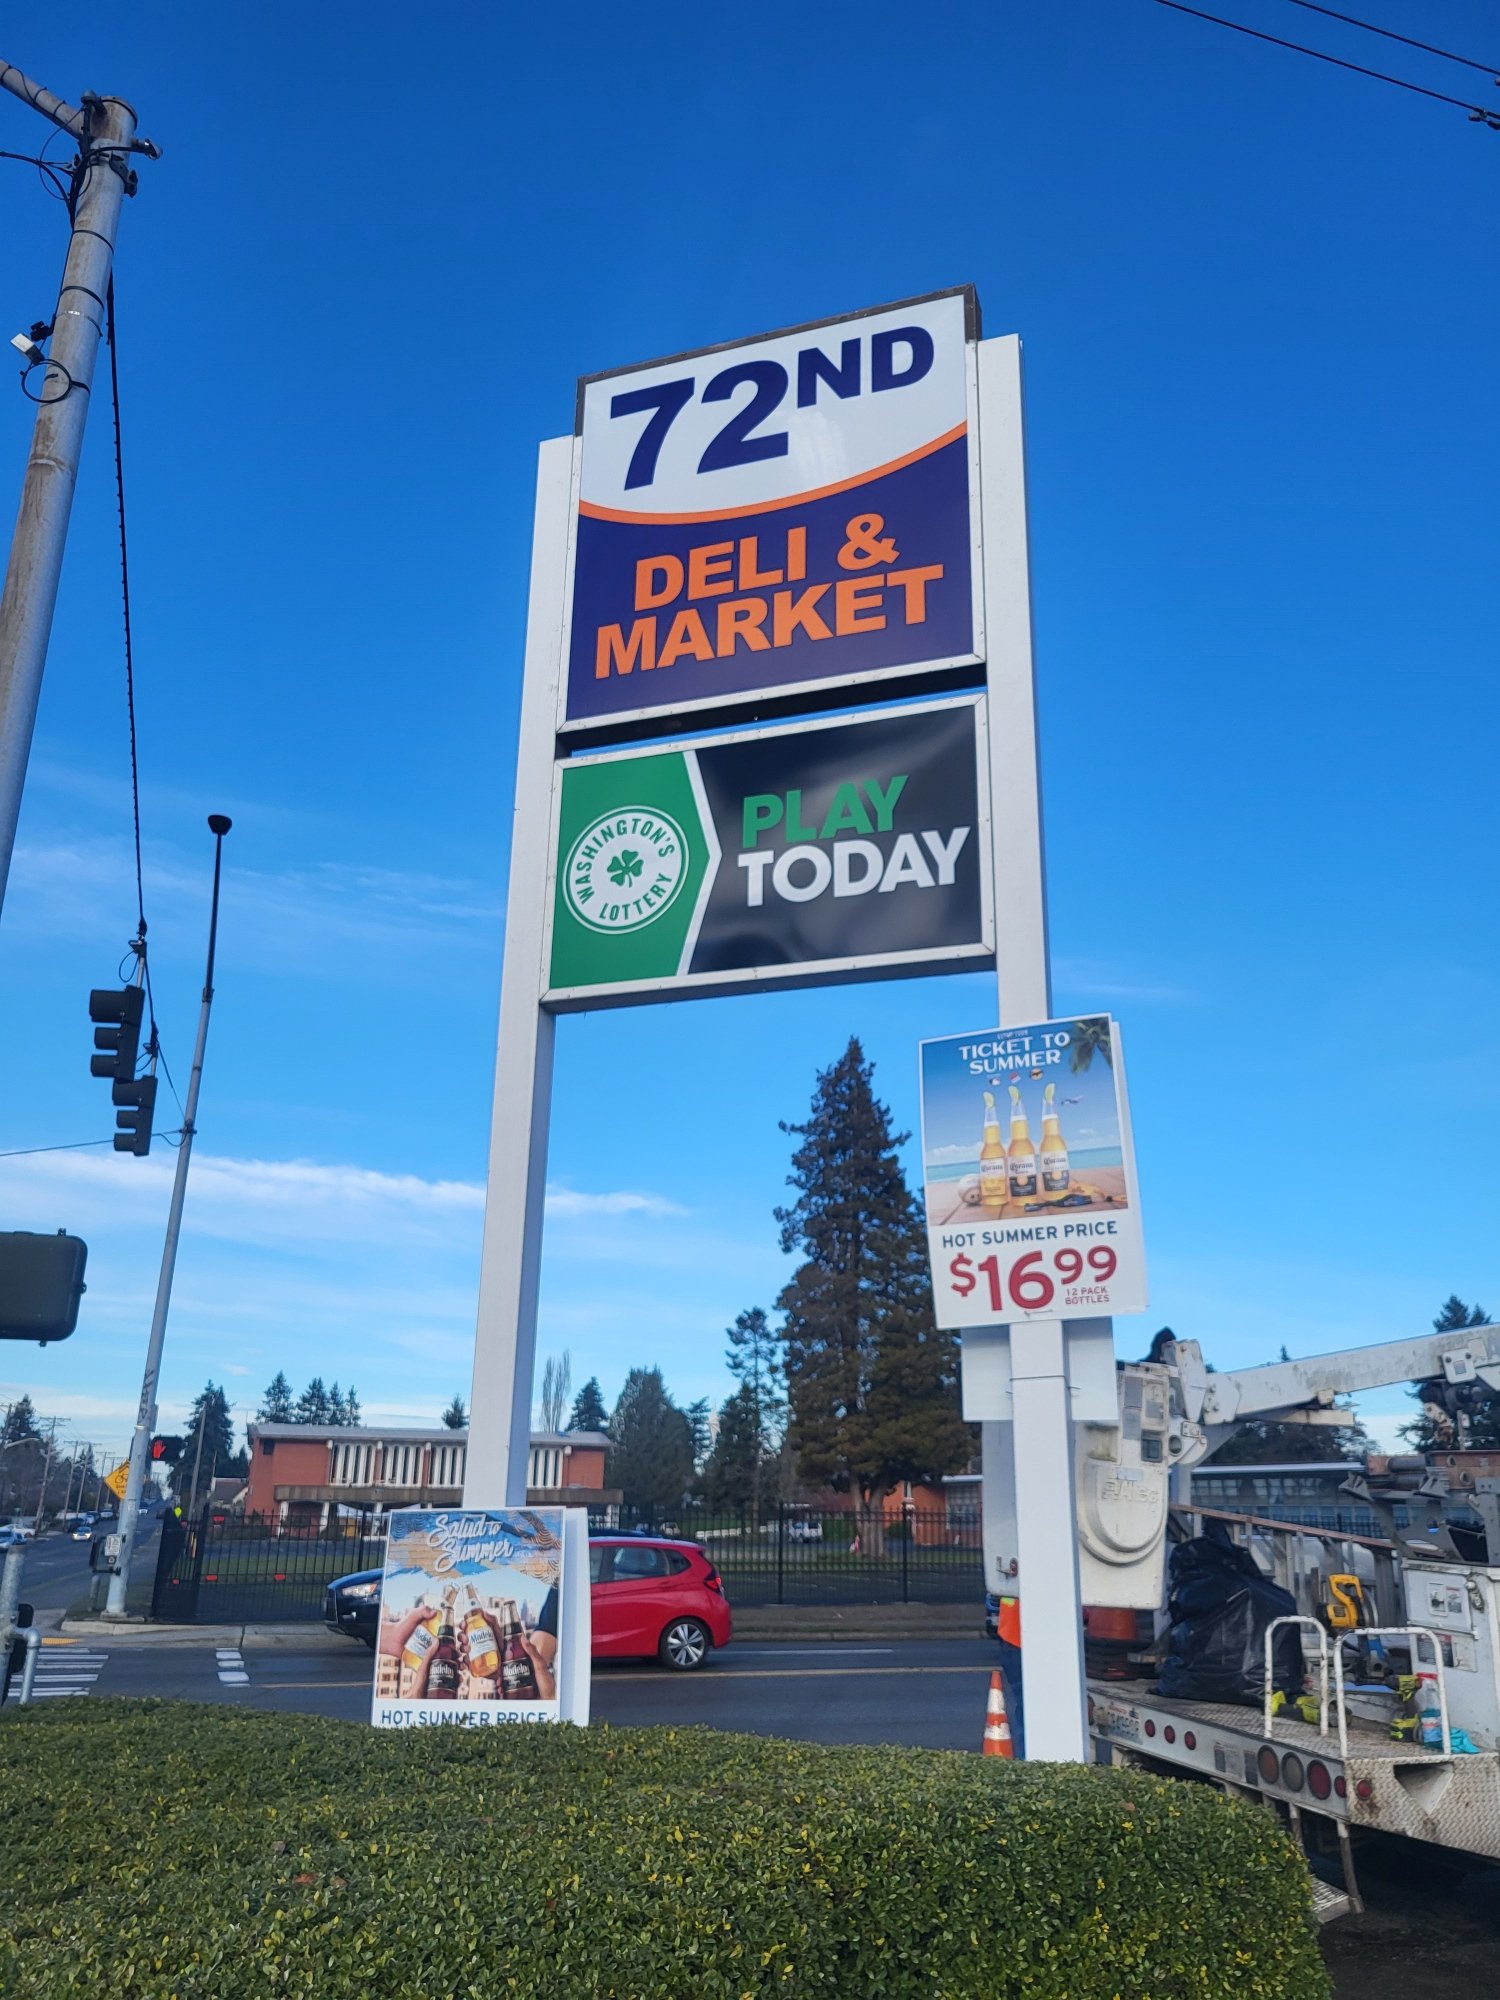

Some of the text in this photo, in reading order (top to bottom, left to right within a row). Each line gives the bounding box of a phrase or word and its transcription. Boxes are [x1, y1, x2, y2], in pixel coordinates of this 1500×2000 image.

[609, 326, 934, 491] 72ND
[634, 513, 900, 612] DELI &
[594, 564, 943, 680] MARKET
[742, 776, 909, 848] PLAY
[575, 818, 675, 905] WASHINGTON'S
[738, 826, 971, 907] TODAY
[599, 872, 672, 921] LOTTERY
[959, 1036, 1032, 1060] TICKET
[1041, 1032, 1070, 1049] TO
[969, 1049, 1061, 1075] SUMMER
[942, 1221, 1118, 1248] HOT SUMMER PRICE
[1065, 1294, 1110, 1305] BOTTLES
[1066, 1285, 1108, 1297] 12 PACK
[427, 1514, 503, 1547] Salud to
[434, 1538, 513, 1573] Summer
[381, 1710, 413, 1725] HOT
[497, 1711, 548, 1725] PRICE
